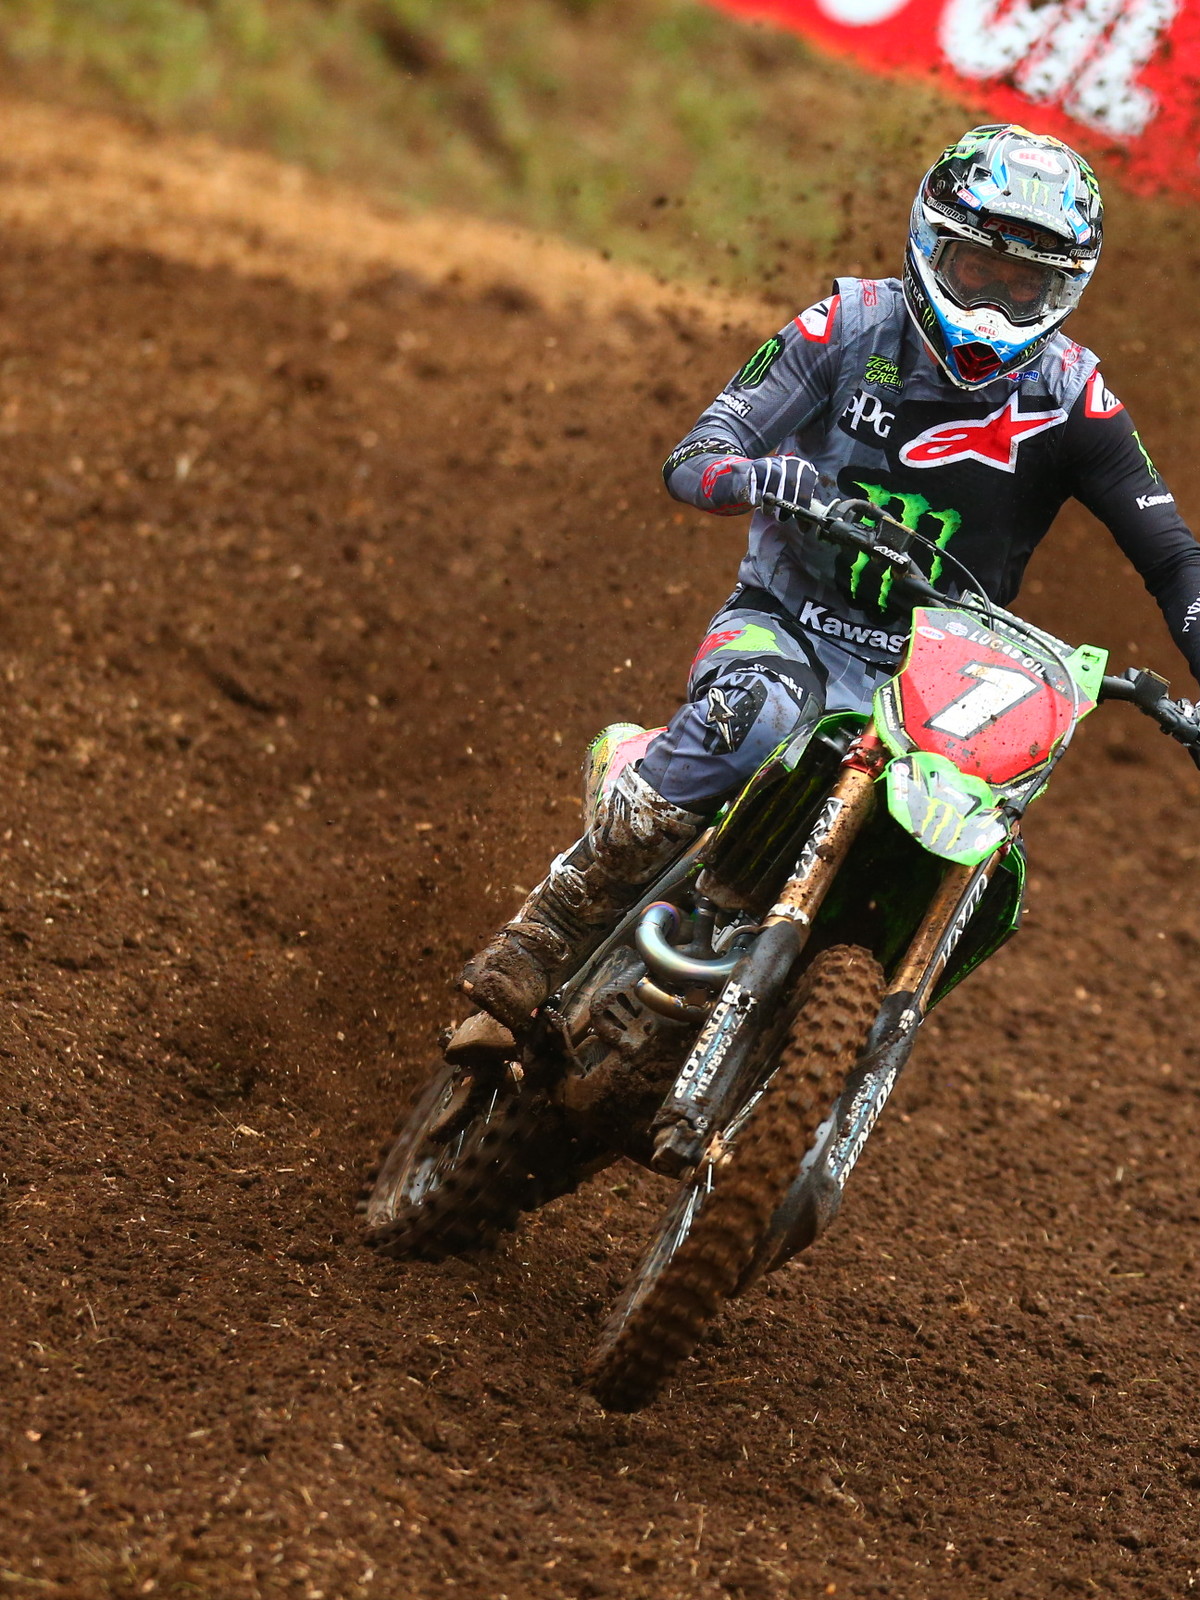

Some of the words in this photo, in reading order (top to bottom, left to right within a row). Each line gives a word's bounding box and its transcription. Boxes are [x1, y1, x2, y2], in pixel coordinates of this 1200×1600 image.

[1019, 152, 1052, 168] BELL
[928, 240, 941, 264] OAKLEY
[978, 325, 997, 336] BELL
[866, 356, 899, 373] TEAM
[842, 391, 895, 439] PPG
[873, 545, 908, 564] ARC
[800, 600, 912, 653] Kawas
[968, 630, 1023, 659] LUCAS
[1022, 655, 1046, 679] OIL
[932, 664, 1037, 737] 1
[674, 981, 742, 1099] DUNLOP
[838, 1067, 897, 1190] DUNLOP
